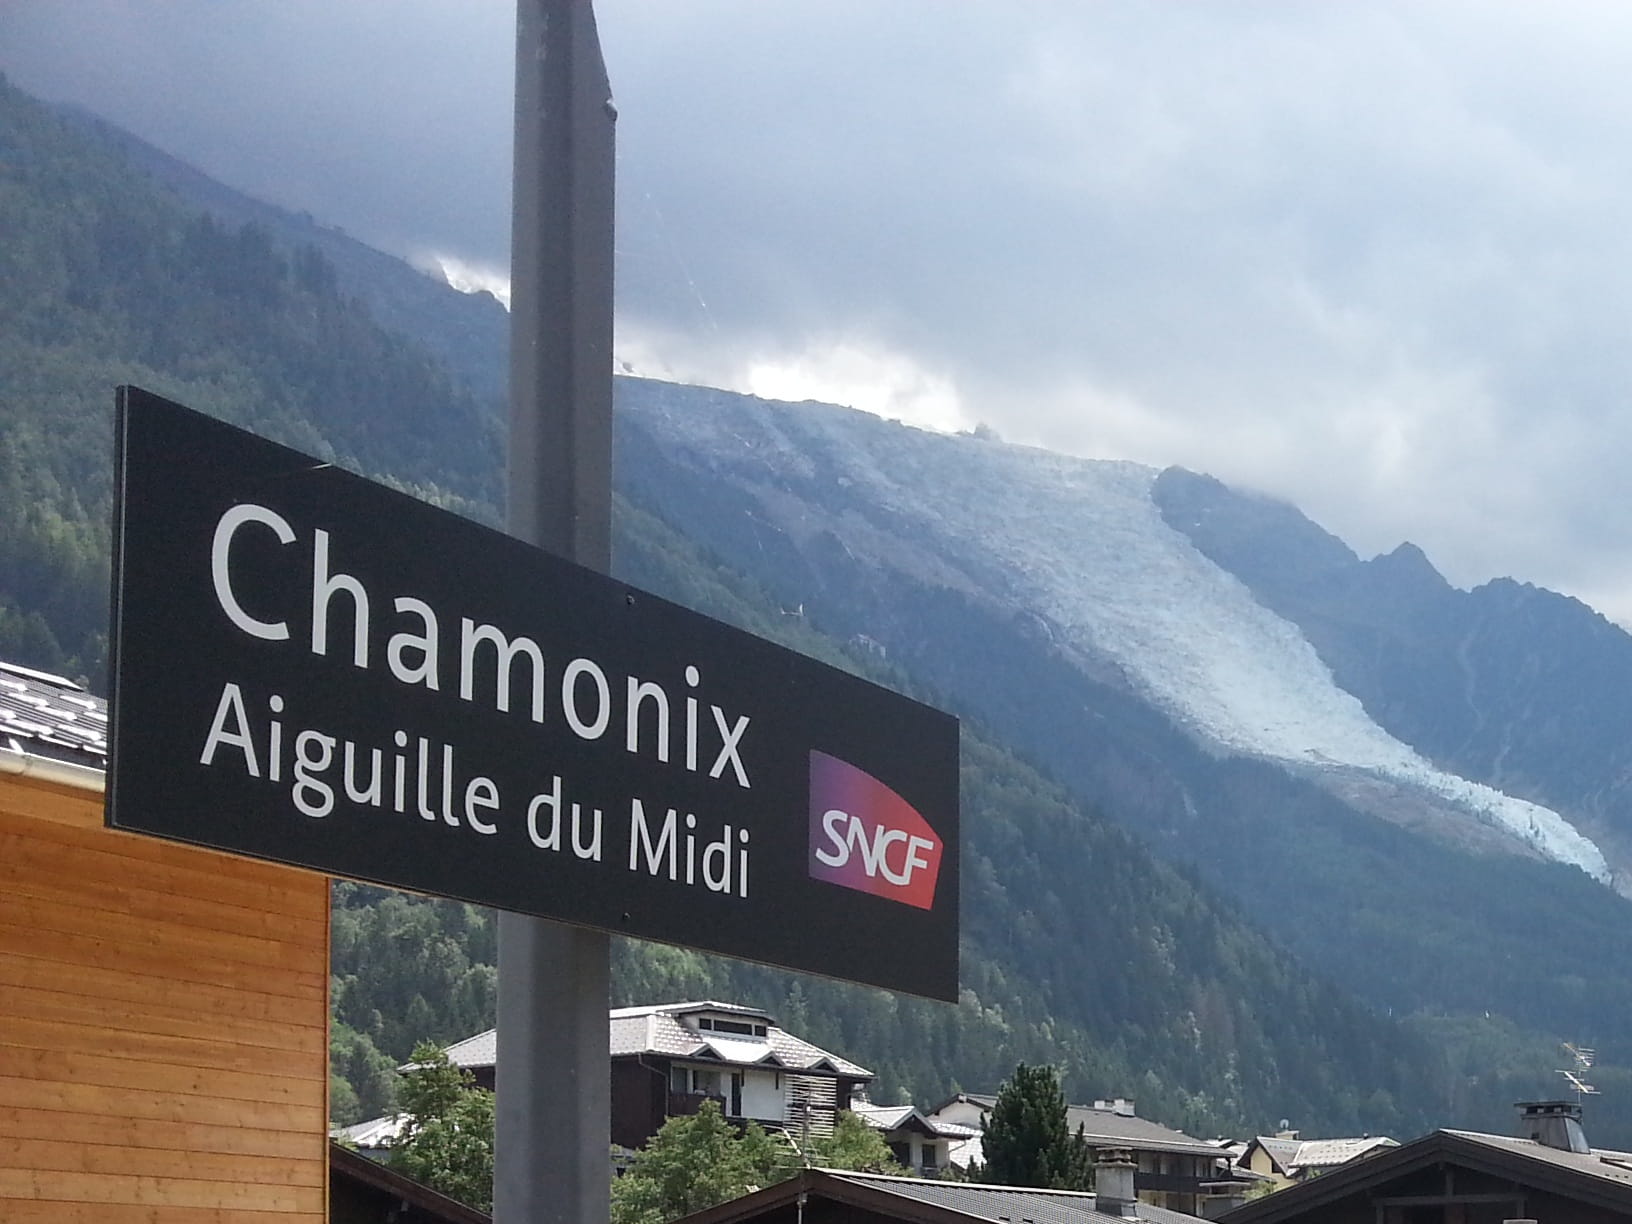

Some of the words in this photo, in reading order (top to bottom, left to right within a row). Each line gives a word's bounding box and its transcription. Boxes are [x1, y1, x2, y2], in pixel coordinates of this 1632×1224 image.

[210, 502, 751, 789] Chamonix
[199, 682, 500, 835] Aiguille
[526, 775, 603, 862] du
[628, 798, 750, 899] Midi
[815, 810, 934, 886] SNCF
